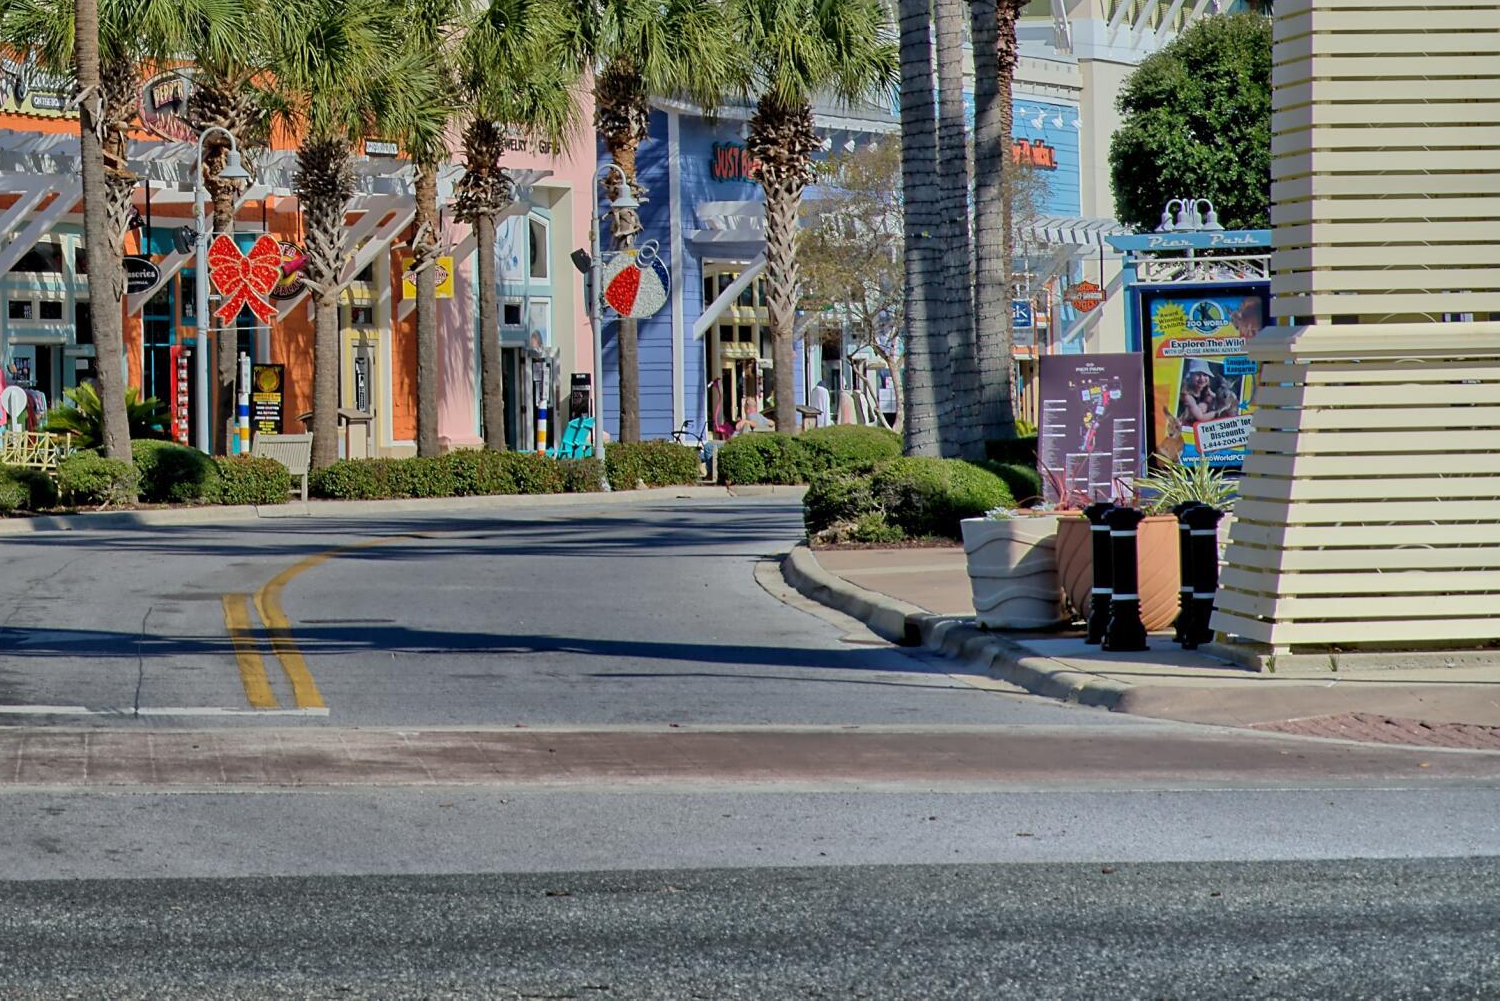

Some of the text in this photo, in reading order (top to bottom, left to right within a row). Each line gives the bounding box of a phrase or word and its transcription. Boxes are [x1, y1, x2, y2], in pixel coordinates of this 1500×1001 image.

[714, 146, 739, 179] JUST
[1148, 233, 1259, 248] Pier Park
[1203, 319, 1229, 327] WORLD
[1171, 338, 1245, 351] Explore The Wild
[1200, 425, 1216, 433] Text
[1241, 418, 1251, 426] for
[1210, 427, 1245, 440] Discounts
